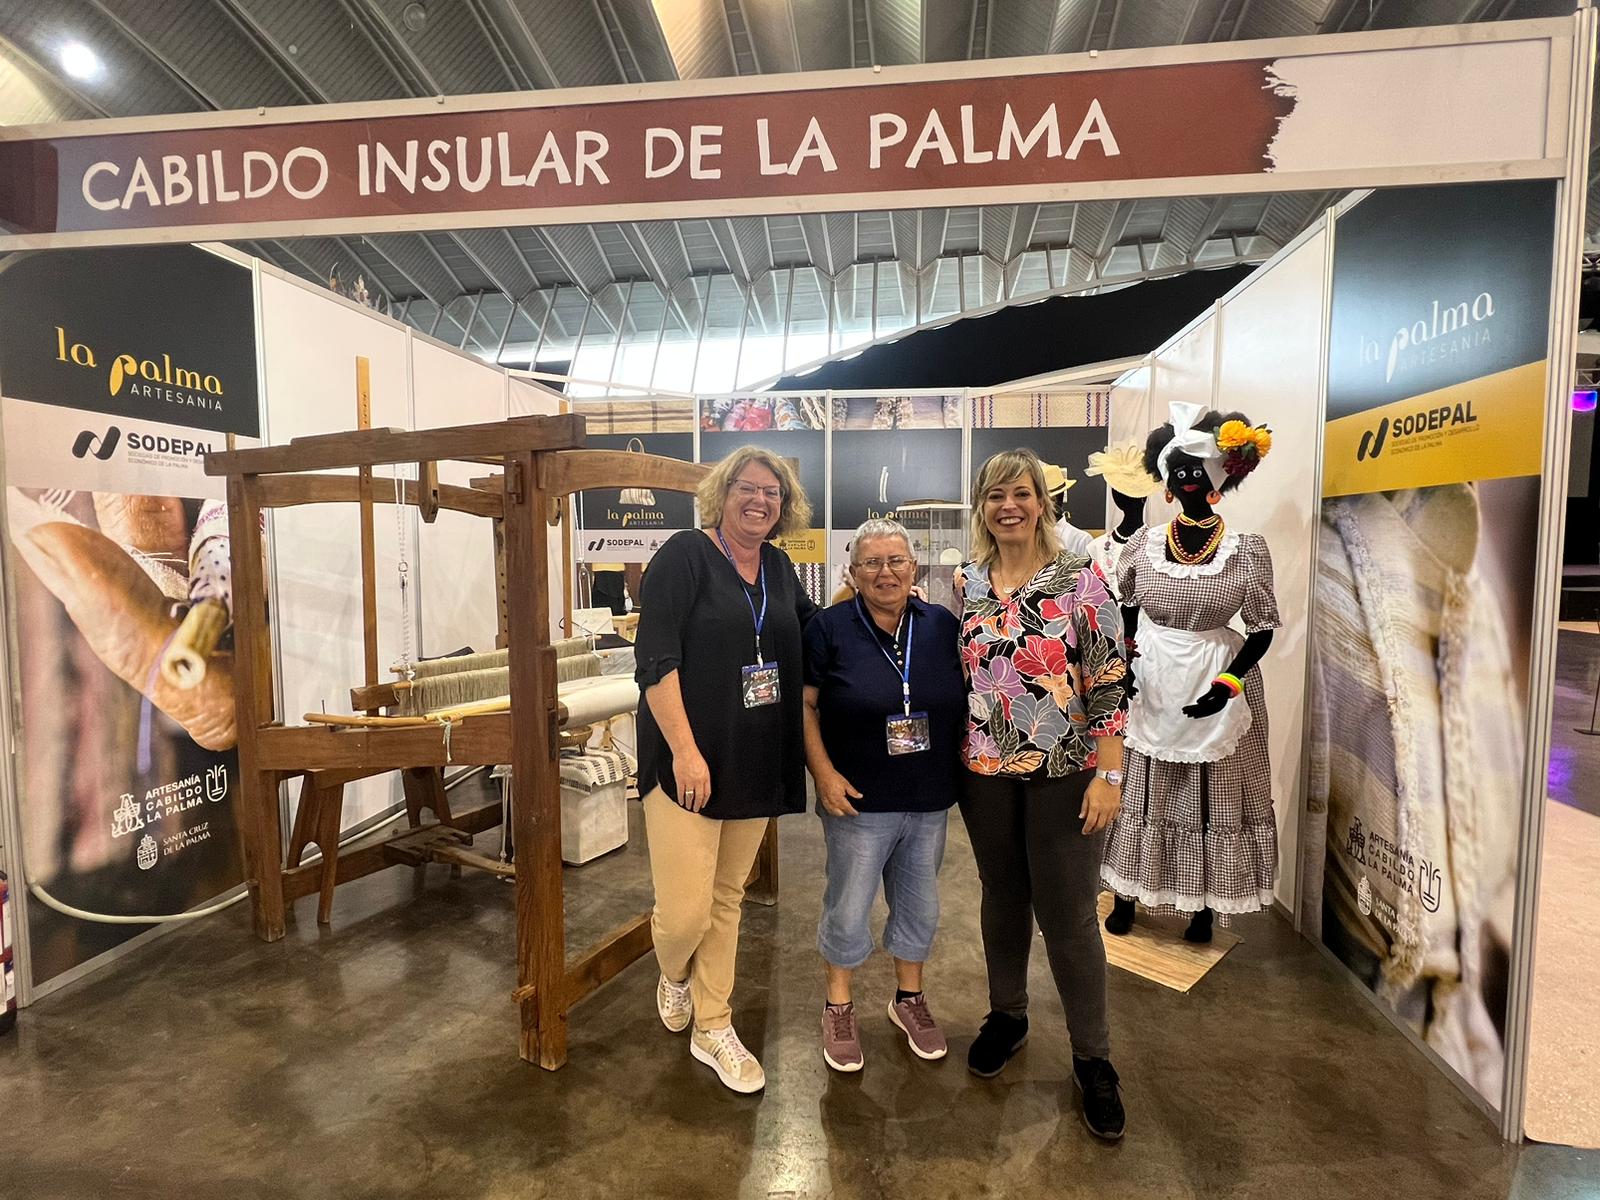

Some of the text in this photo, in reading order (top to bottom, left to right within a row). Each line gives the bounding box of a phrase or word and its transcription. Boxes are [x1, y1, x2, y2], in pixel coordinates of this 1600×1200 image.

[82, 98, 1121, 212] CABILDO INSULAR DE LA PALMA
[1360, 292, 1495, 383] la palma
[55, 326, 224, 396] la palma
[130, 383, 224, 412] ARTESANIA
[1392, 400, 1477, 438] SODEPAL
[607, 508, 664, 527] la palma
[867, 507, 880, 519] la
[145, 773, 201, 800] ARTESANÍA
[146, 785, 202, 811] CABILDO
[147, 796, 203, 824] LA PALMA
[189, 821, 209, 835] CRUZ
[1368, 844, 1415, 881] CABILDO
[1368, 859, 1414, 897] LA PALMA
